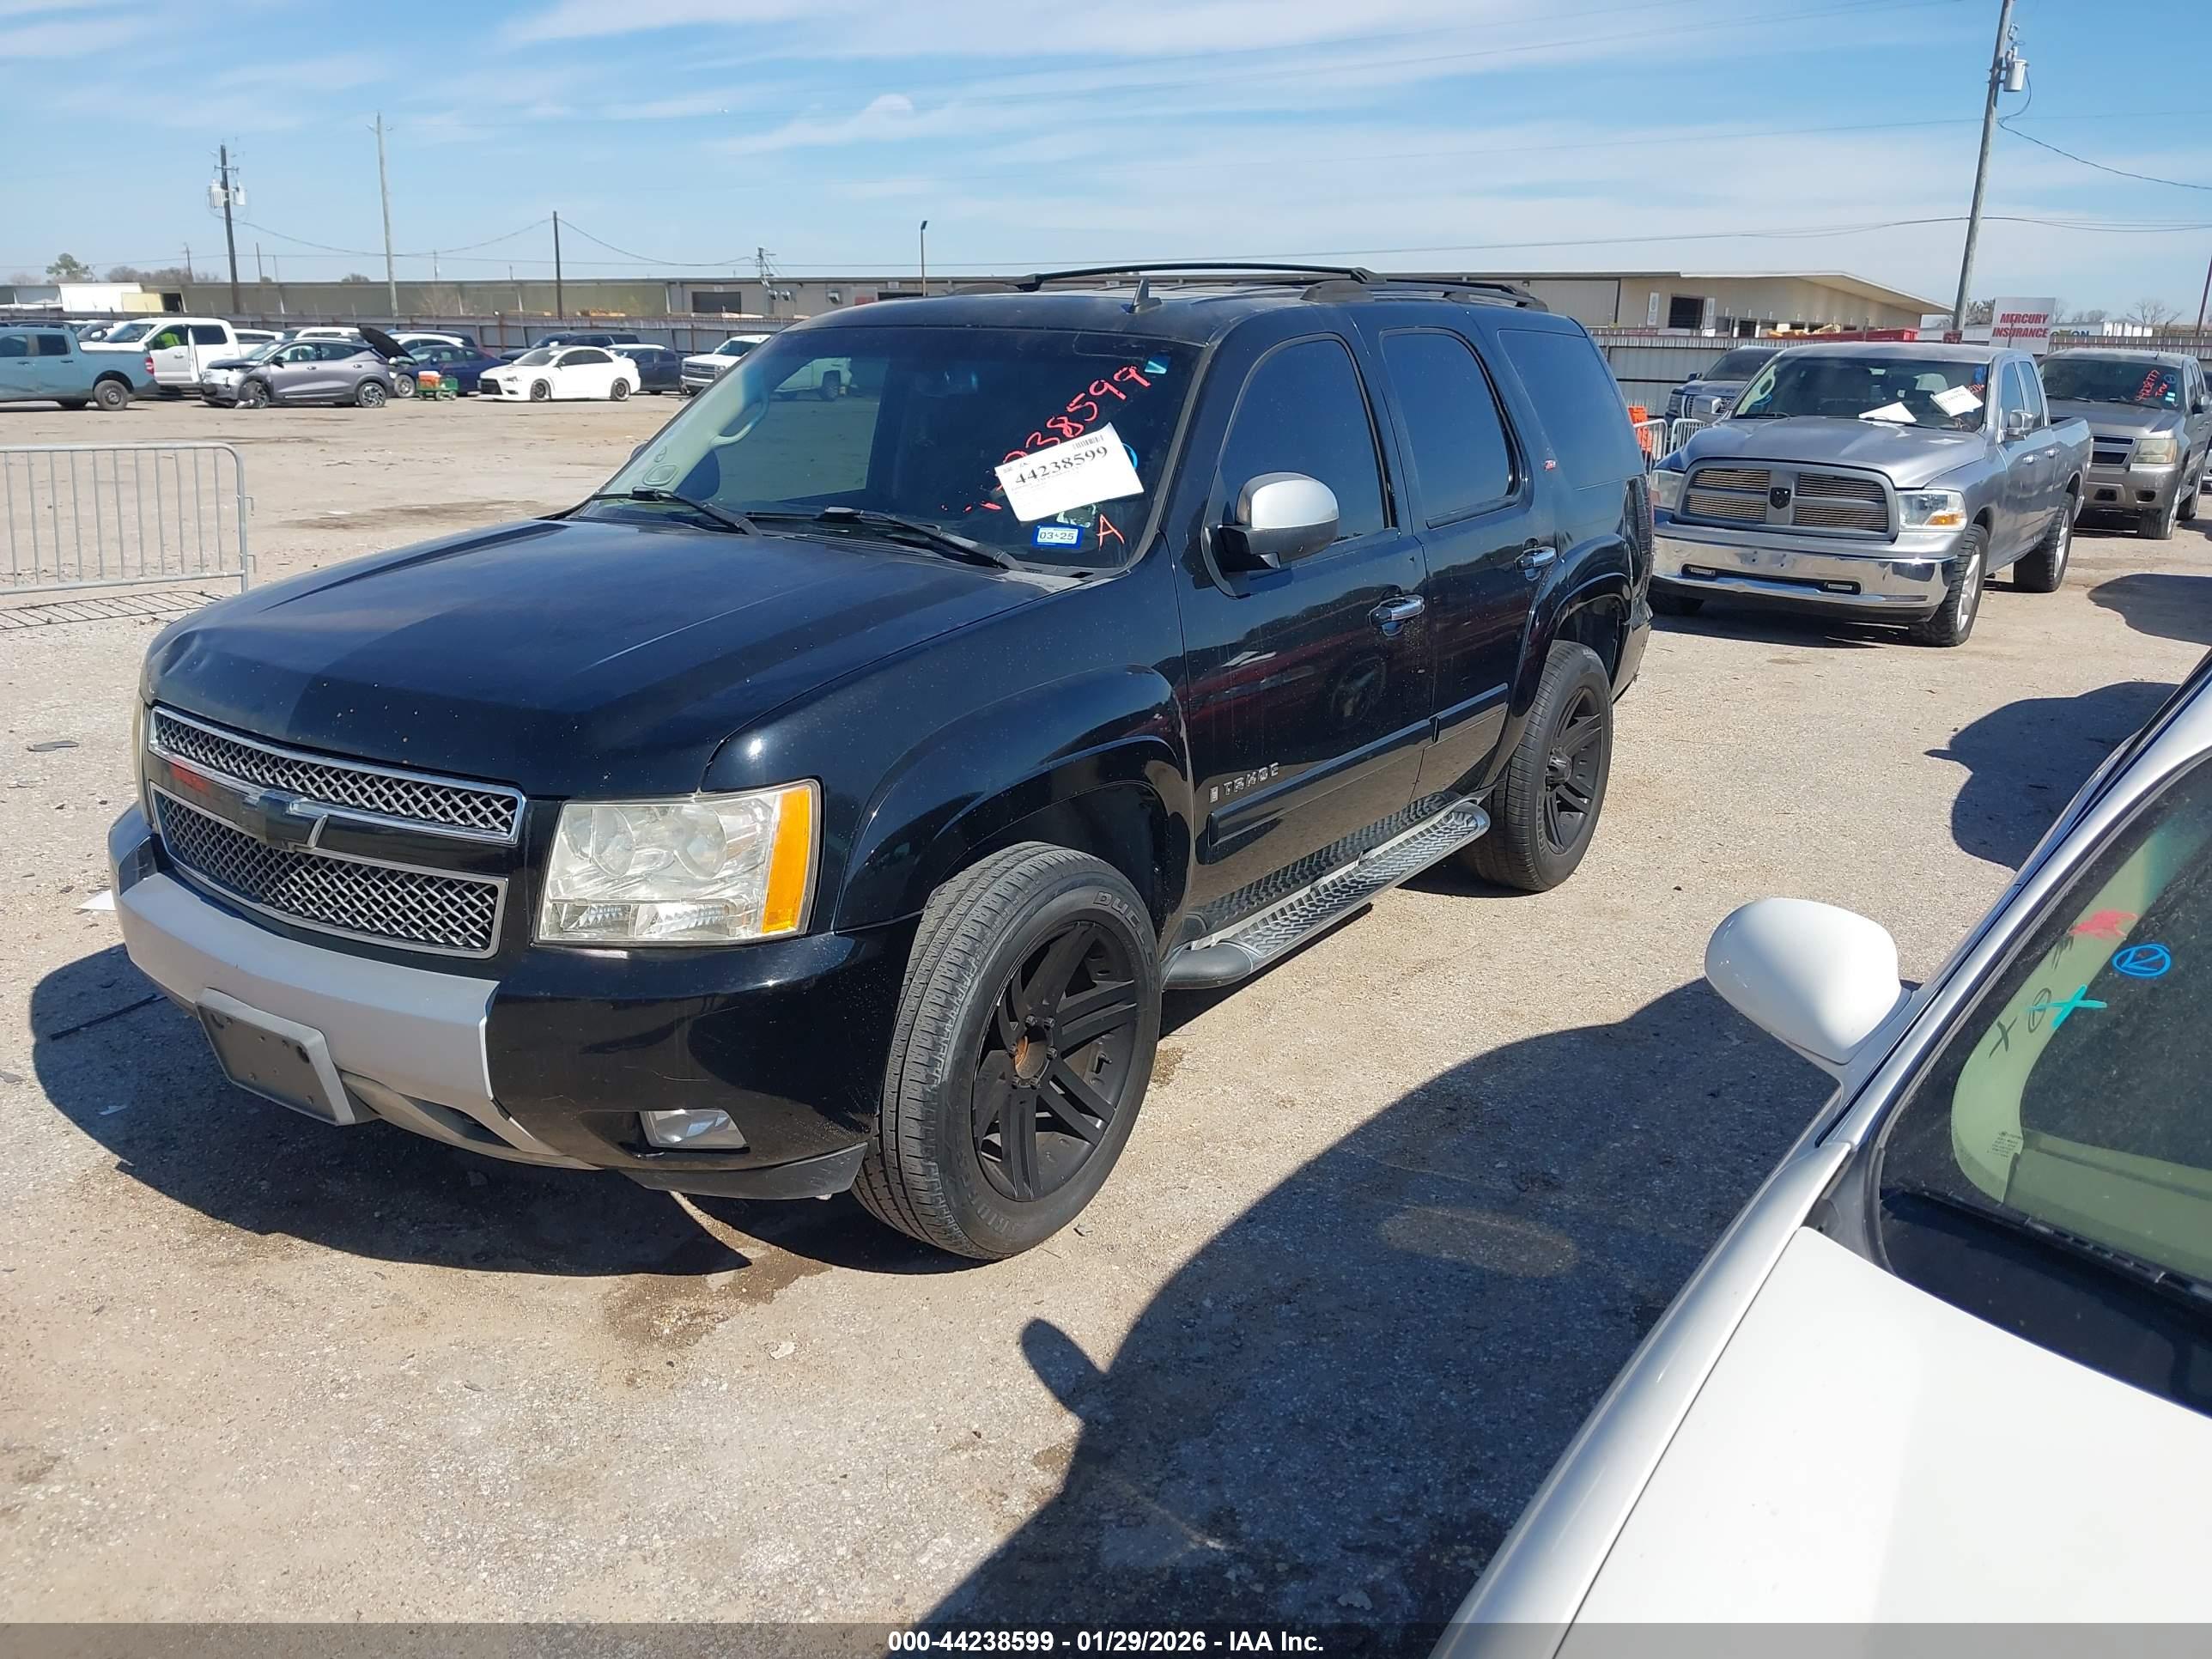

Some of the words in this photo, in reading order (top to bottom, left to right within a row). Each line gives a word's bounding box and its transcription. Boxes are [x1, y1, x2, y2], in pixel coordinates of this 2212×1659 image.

[2000, 313, 2049, 324] MERCURY
[1992, 327, 2049, 337] INSURANCE
[1015, 446, 1109, 484] 44238599
[1223, 762, 1279, 796] TAHOE
